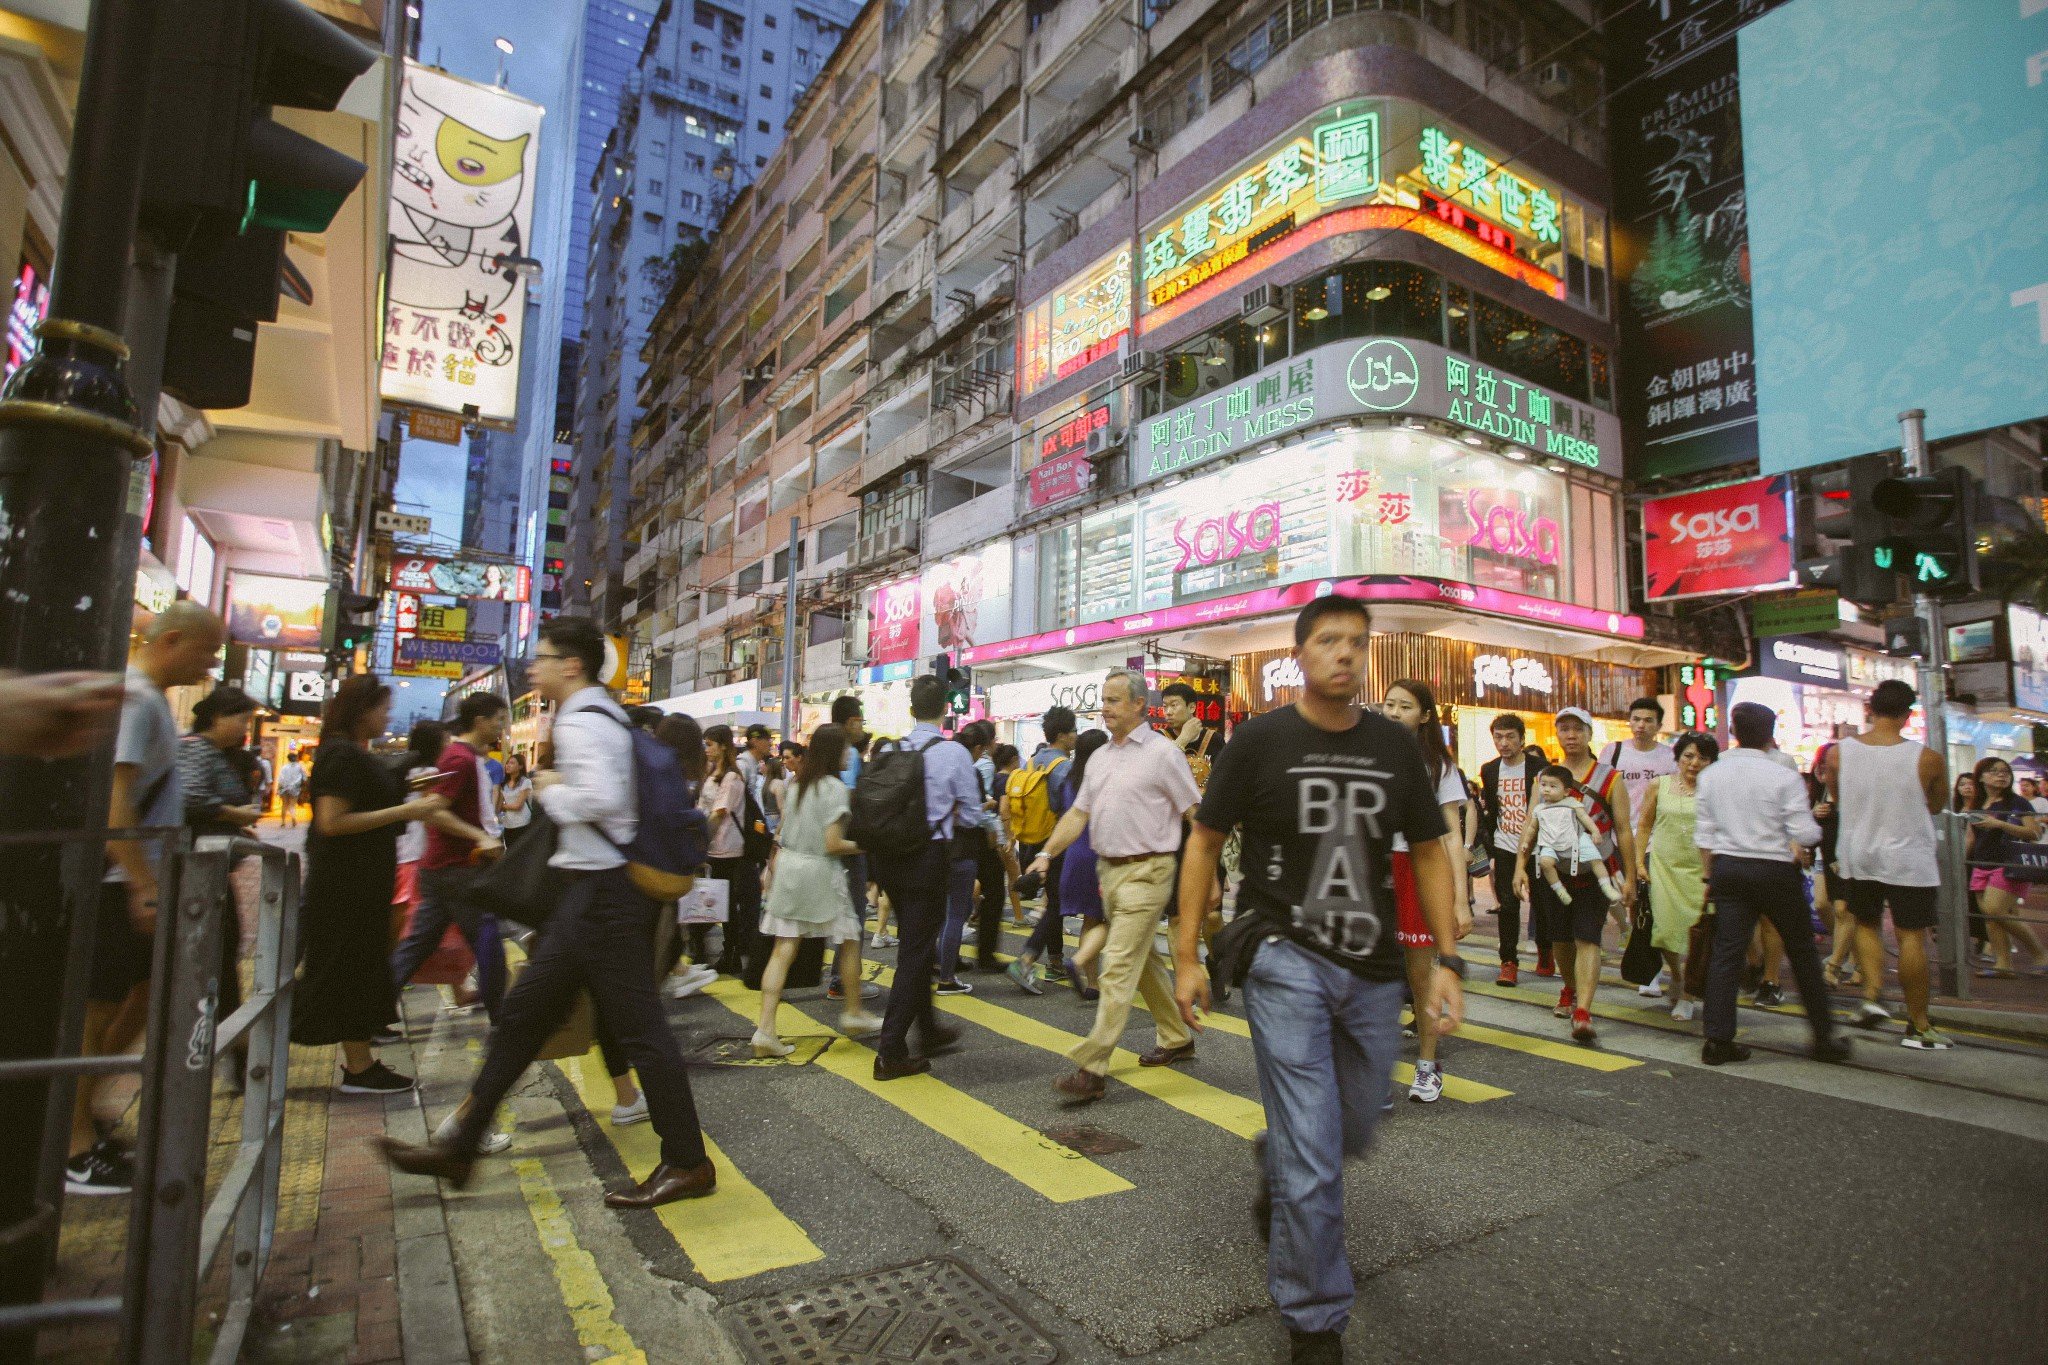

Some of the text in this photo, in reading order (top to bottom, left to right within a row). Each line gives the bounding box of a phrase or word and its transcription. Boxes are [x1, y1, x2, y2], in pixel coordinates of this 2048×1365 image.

[1668, 90, 1735, 129] QUALIT
[1419, 127, 1561, 243] 翡翠世家
[1646, 351, 1755, 399] 金朝陽中
[1446, 397, 1600, 468] ALADIN MESS
[1647, 380, 1757, 428] 銅鑼灣廣
[1147, 396, 1316, 477] ALADIN MESS
[1056, 460, 1073, 473] Box
[1336, 469, 1412, 526] 莎莎
[1298, 777, 1387, 840] BR
[1316, 845, 1360, 902] A
